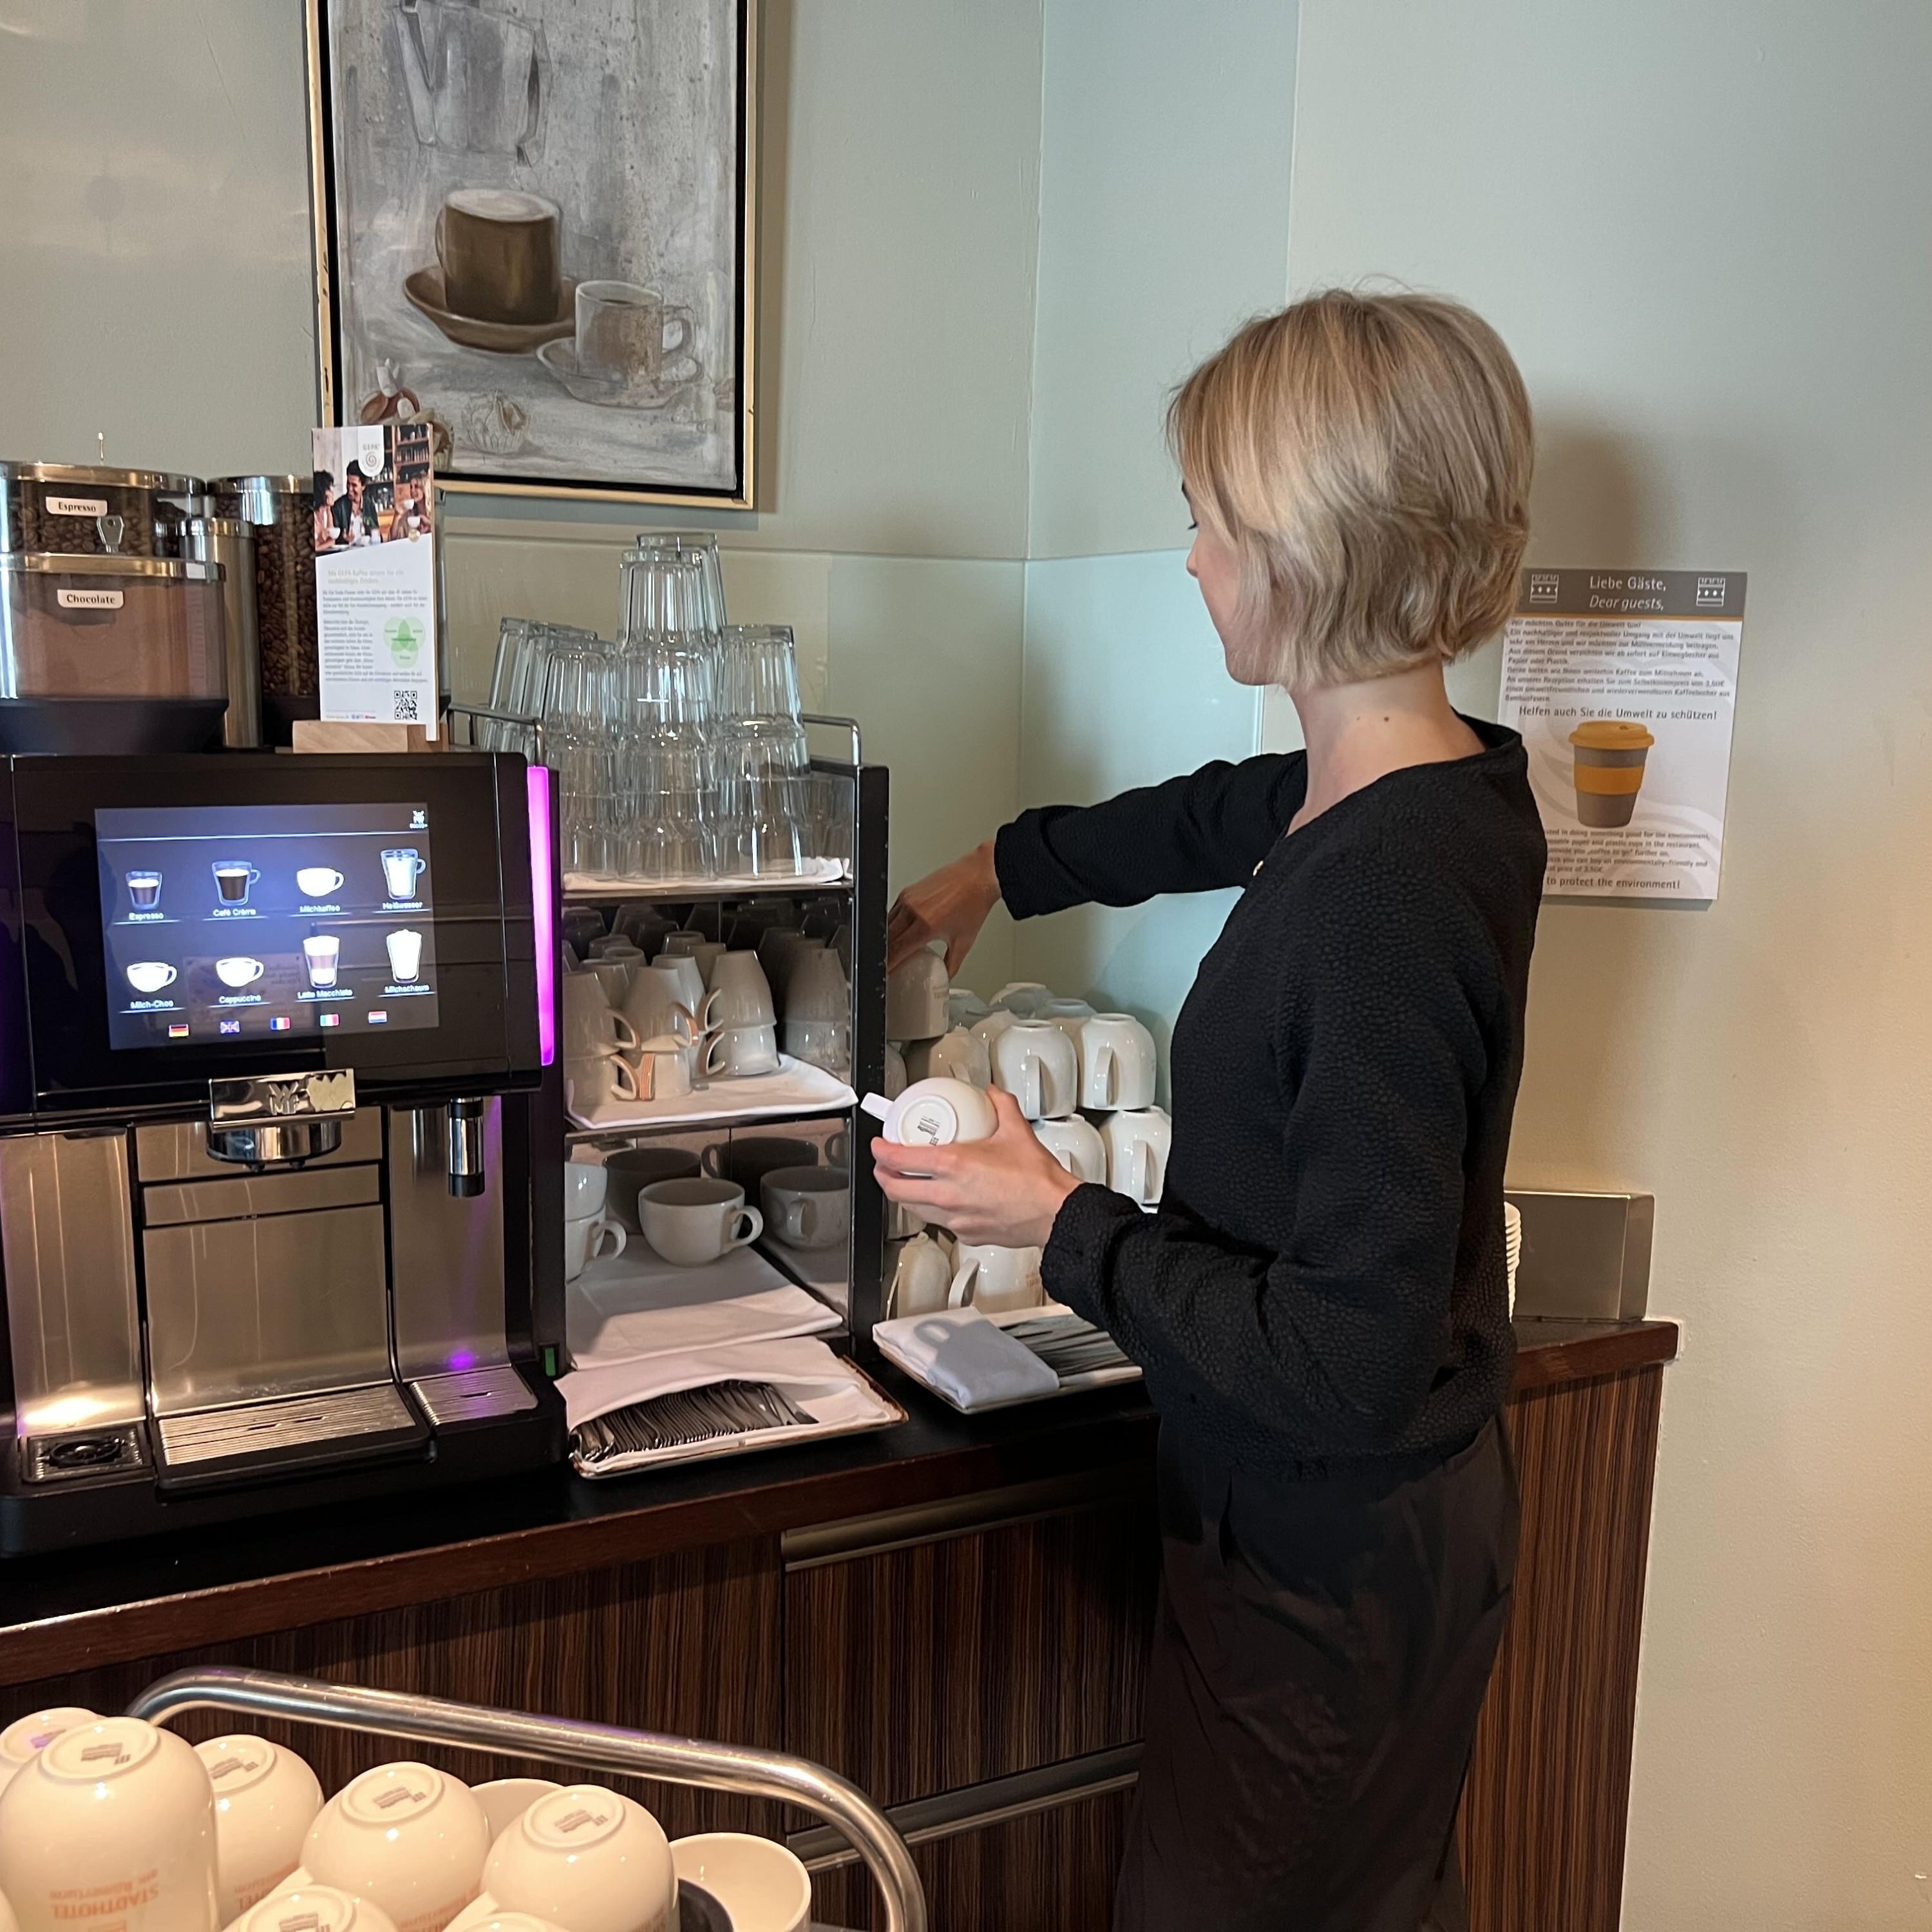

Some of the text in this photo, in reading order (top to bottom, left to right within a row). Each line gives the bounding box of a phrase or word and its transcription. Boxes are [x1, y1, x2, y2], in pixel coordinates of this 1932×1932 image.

[59, 502, 97, 513] Espresso
[1589, 576, 1666, 591] Liebe Gäste,
[66, 594, 115, 605] Chocolate
[1589, 595, 1663, 611] Dear guests,
[1519, 706, 1550, 716] Helfen
[1554, 707, 1576, 717] auch
[1580, 707, 1595, 717] Sie
[1598, 707, 1612, 717] die
[1616, 708, 1652, 718] Umwelt
[1671, 710, 1717, 719] schützen!
[1547, 876, 1680, 889] to protect the environment!
[213, 909, 231, 917] Café
[299, 905, 341, 913] Milchkaffee
[129, 913, 164, 921] Espresso
[317, 989, 353, 998] Macchiato
[385, 984, 430, 993] Milchschaum
[219, 995, 261, 1004] Cappuccino
[268, 1081, 299, 1115] WMF
